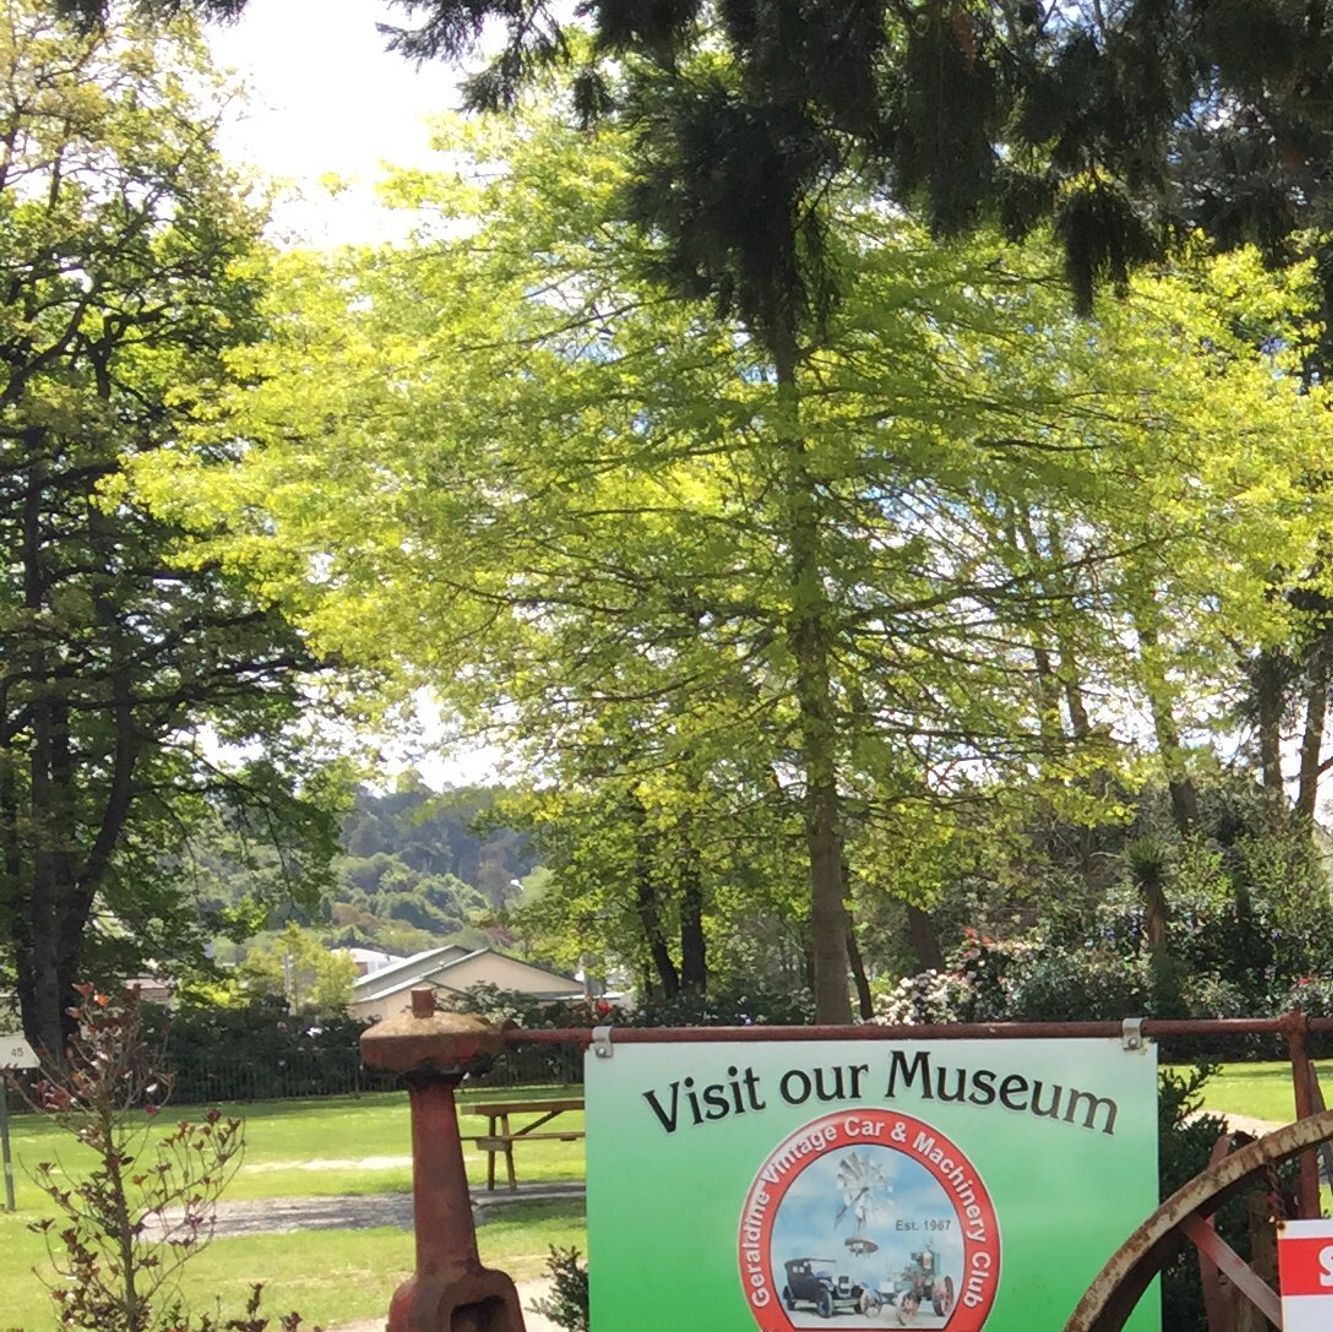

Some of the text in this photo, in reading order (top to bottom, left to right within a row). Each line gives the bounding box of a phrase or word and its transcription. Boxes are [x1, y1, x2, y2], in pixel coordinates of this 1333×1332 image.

[643, 1049, 1120, 1135] Visit our Museum
[761, 1124, 837, 1185] Vintage
[844, 1116, 885, 1137] Car
[890, 1121, 907, 1142] &
[912, 1131, 987, 1243] Machinery
[964, 1251, 991, 1308] Club
